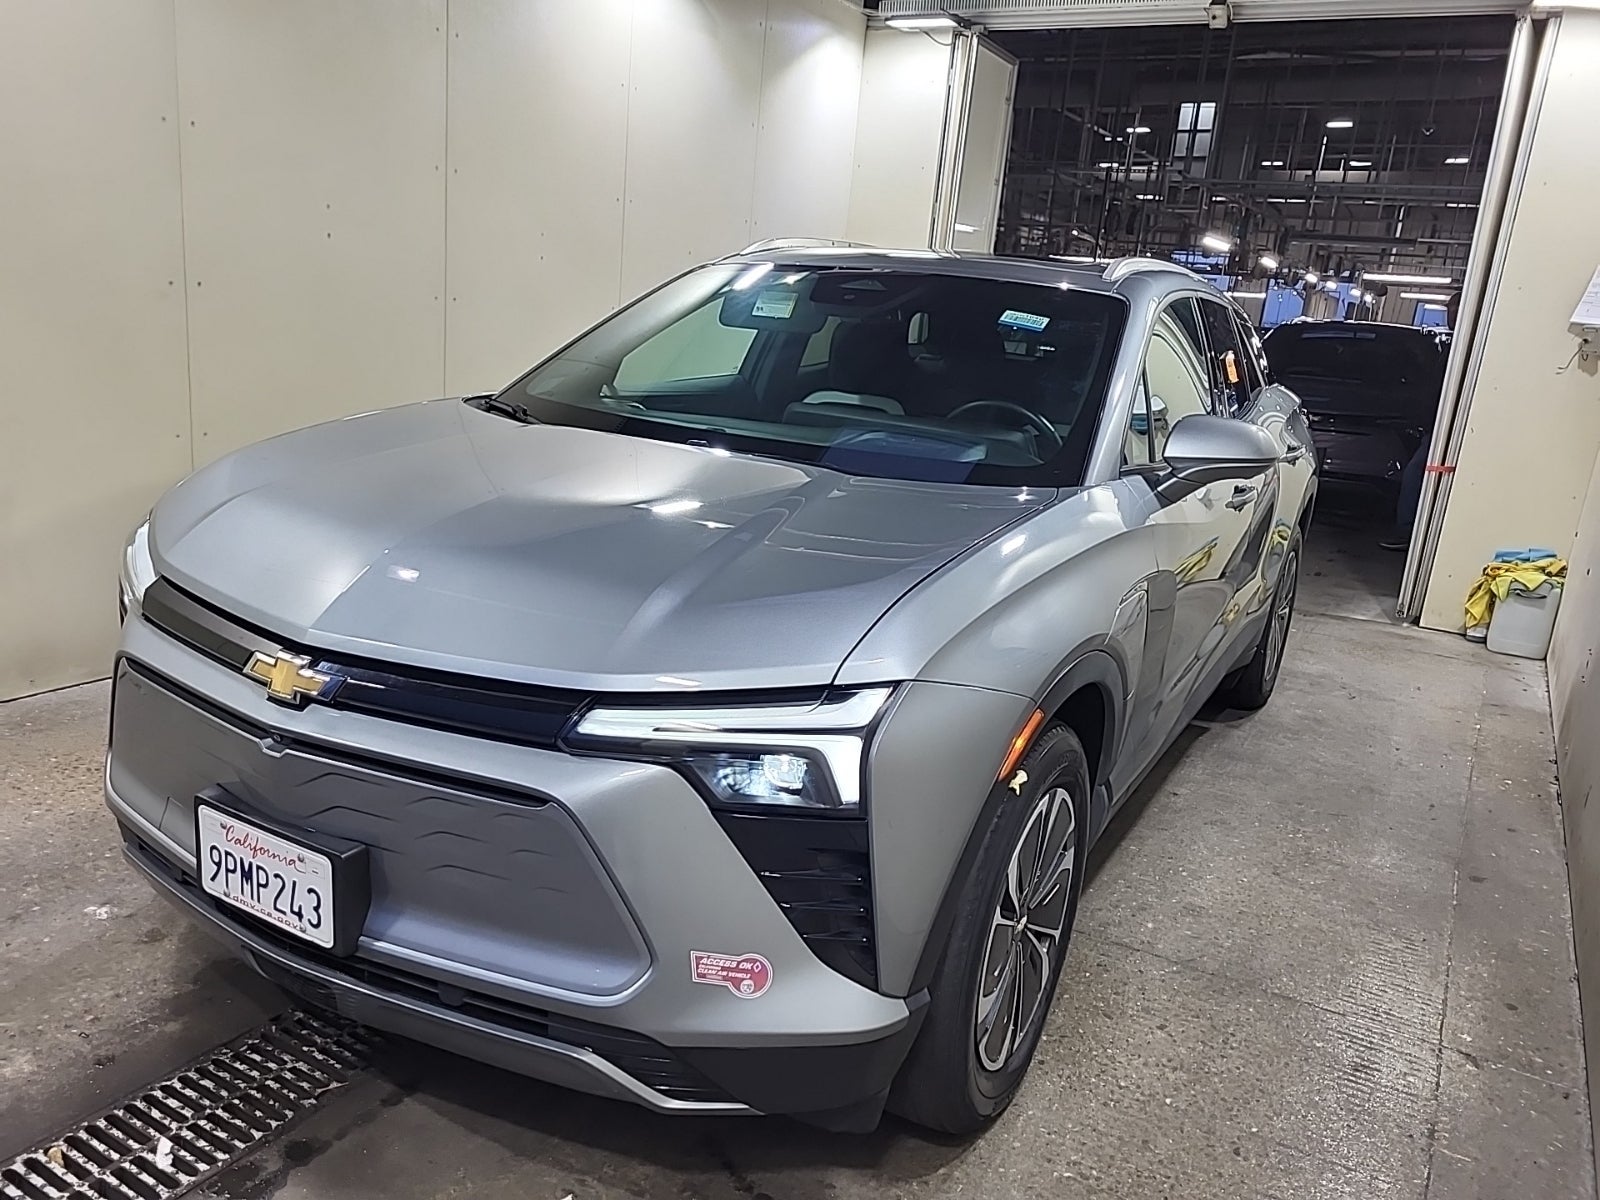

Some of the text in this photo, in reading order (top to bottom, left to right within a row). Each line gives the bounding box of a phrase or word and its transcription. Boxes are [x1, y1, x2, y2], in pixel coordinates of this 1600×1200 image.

[225, 824, 306, 874] California
[209, 844, 322, 929] 9PMP243
[232, 895, 299, 930] dmv.ca.gov
[700, 957, 738, 968] ACCESS
[739, 962, 753, 970] OK
